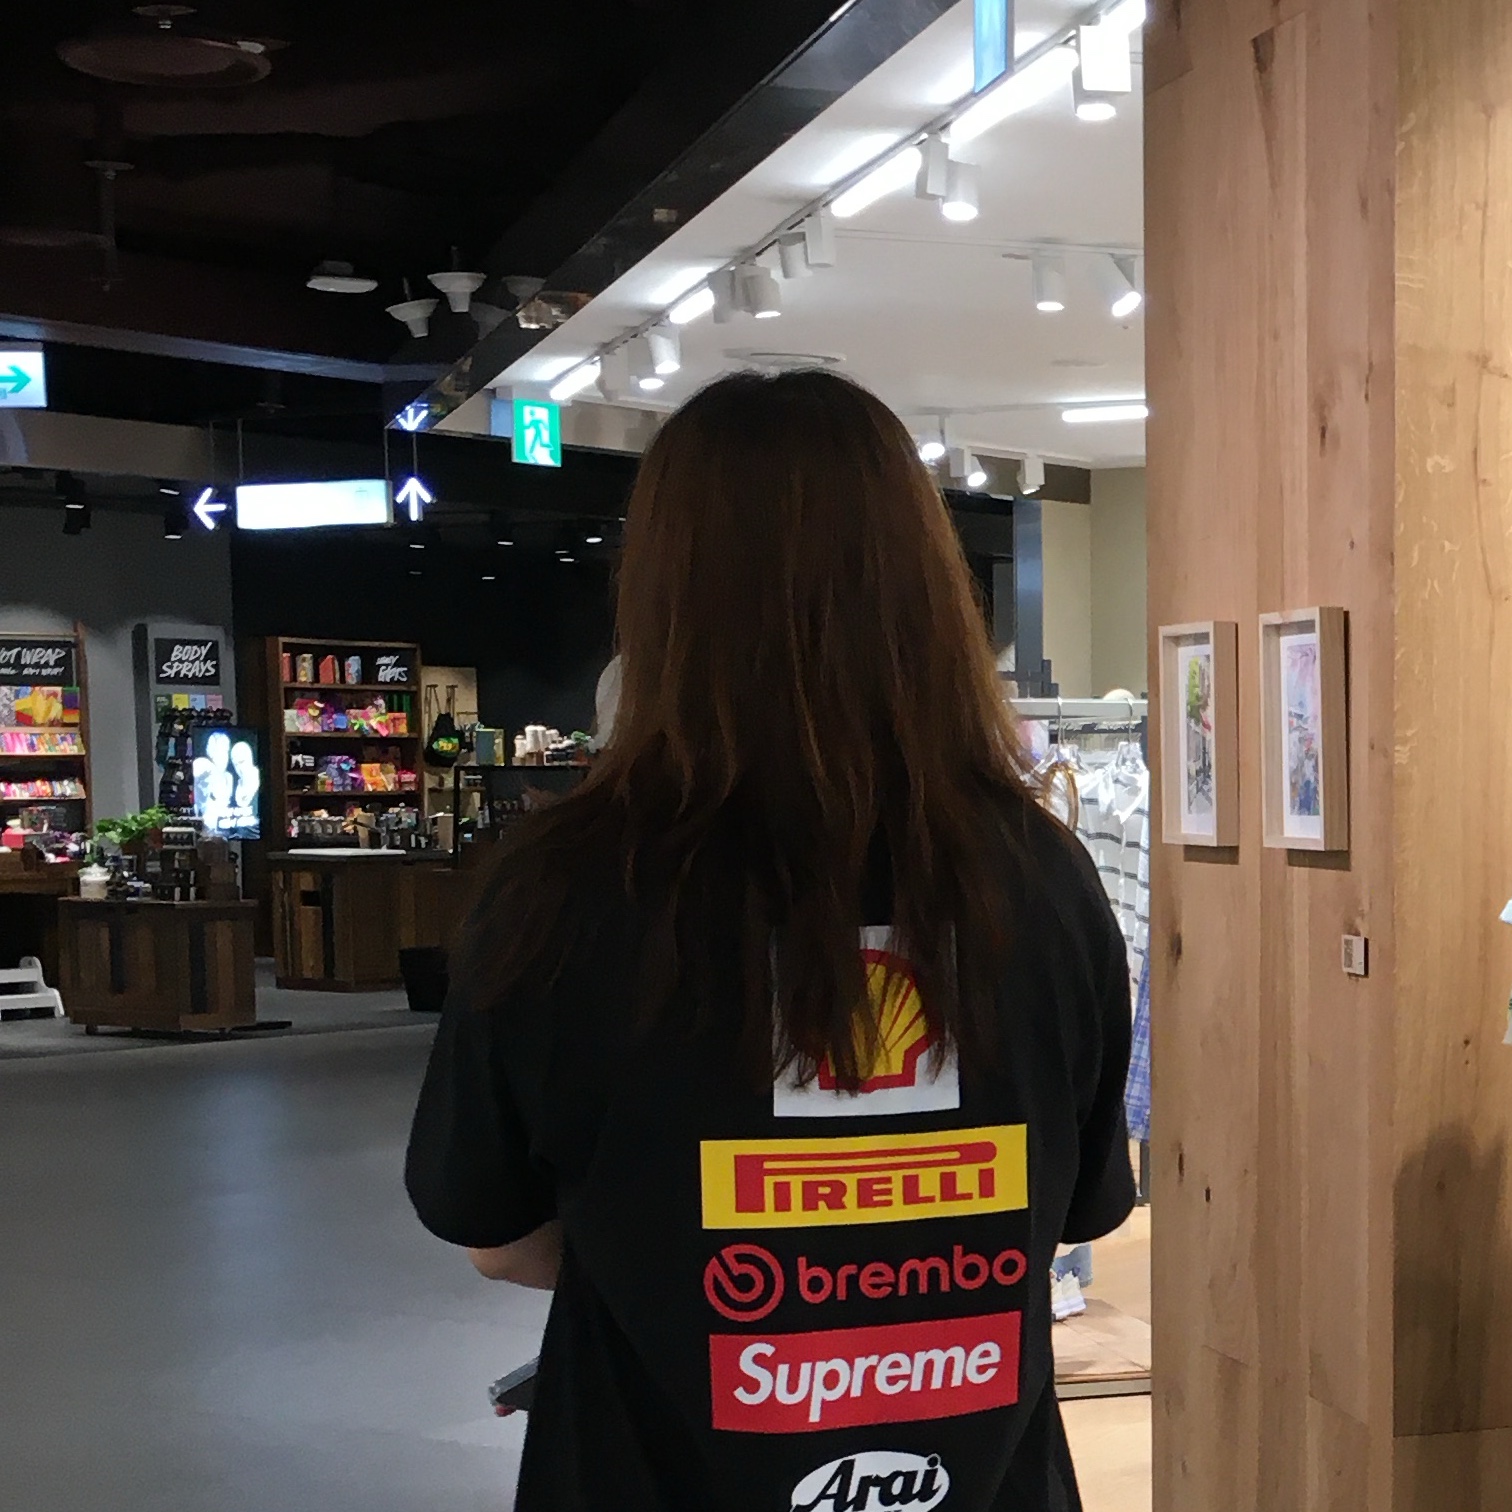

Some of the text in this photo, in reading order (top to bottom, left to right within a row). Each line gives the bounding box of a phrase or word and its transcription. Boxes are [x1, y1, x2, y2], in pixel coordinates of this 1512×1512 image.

[0, 647, 66, 666] OT WRAP
[159, 660, 217, 678] SPRAYS
[170, 642, 213, 662] BODY
[734, 1141, 998, 1214] PIRELLI
[797, 1245, 1027, 1304] brembo
[733, 1340, 1001, 1423] Supreme
